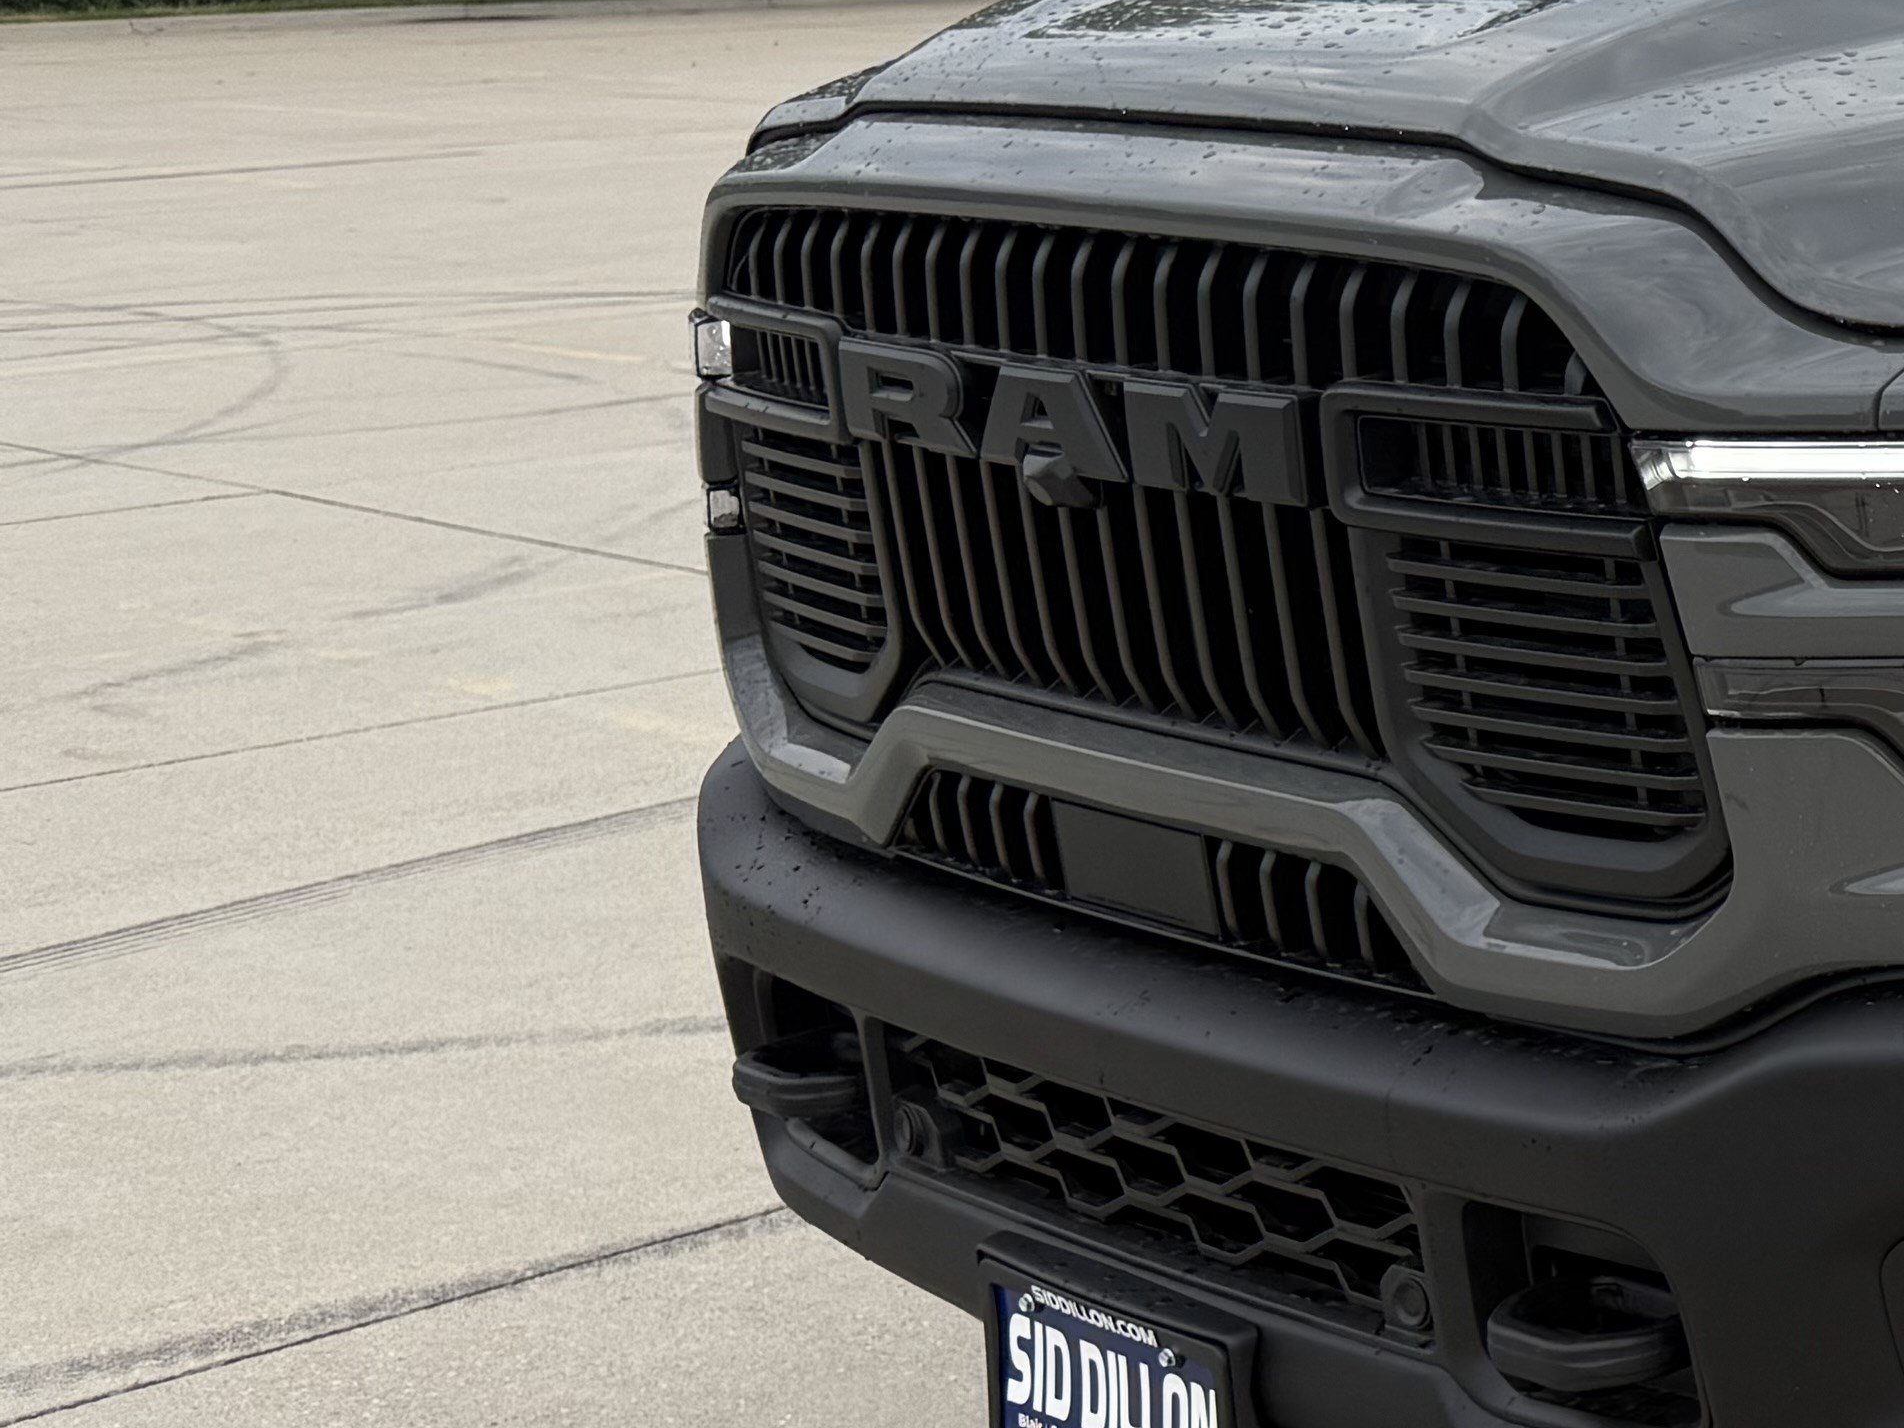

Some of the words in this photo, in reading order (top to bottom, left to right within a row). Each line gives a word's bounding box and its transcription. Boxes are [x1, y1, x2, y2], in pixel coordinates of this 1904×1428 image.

[837, 334, 1310, 509] RAM
[1006, 1312, 1072, 1422] SID
[1030, 1284, 1159, 1348] SIDDILLON.COM
